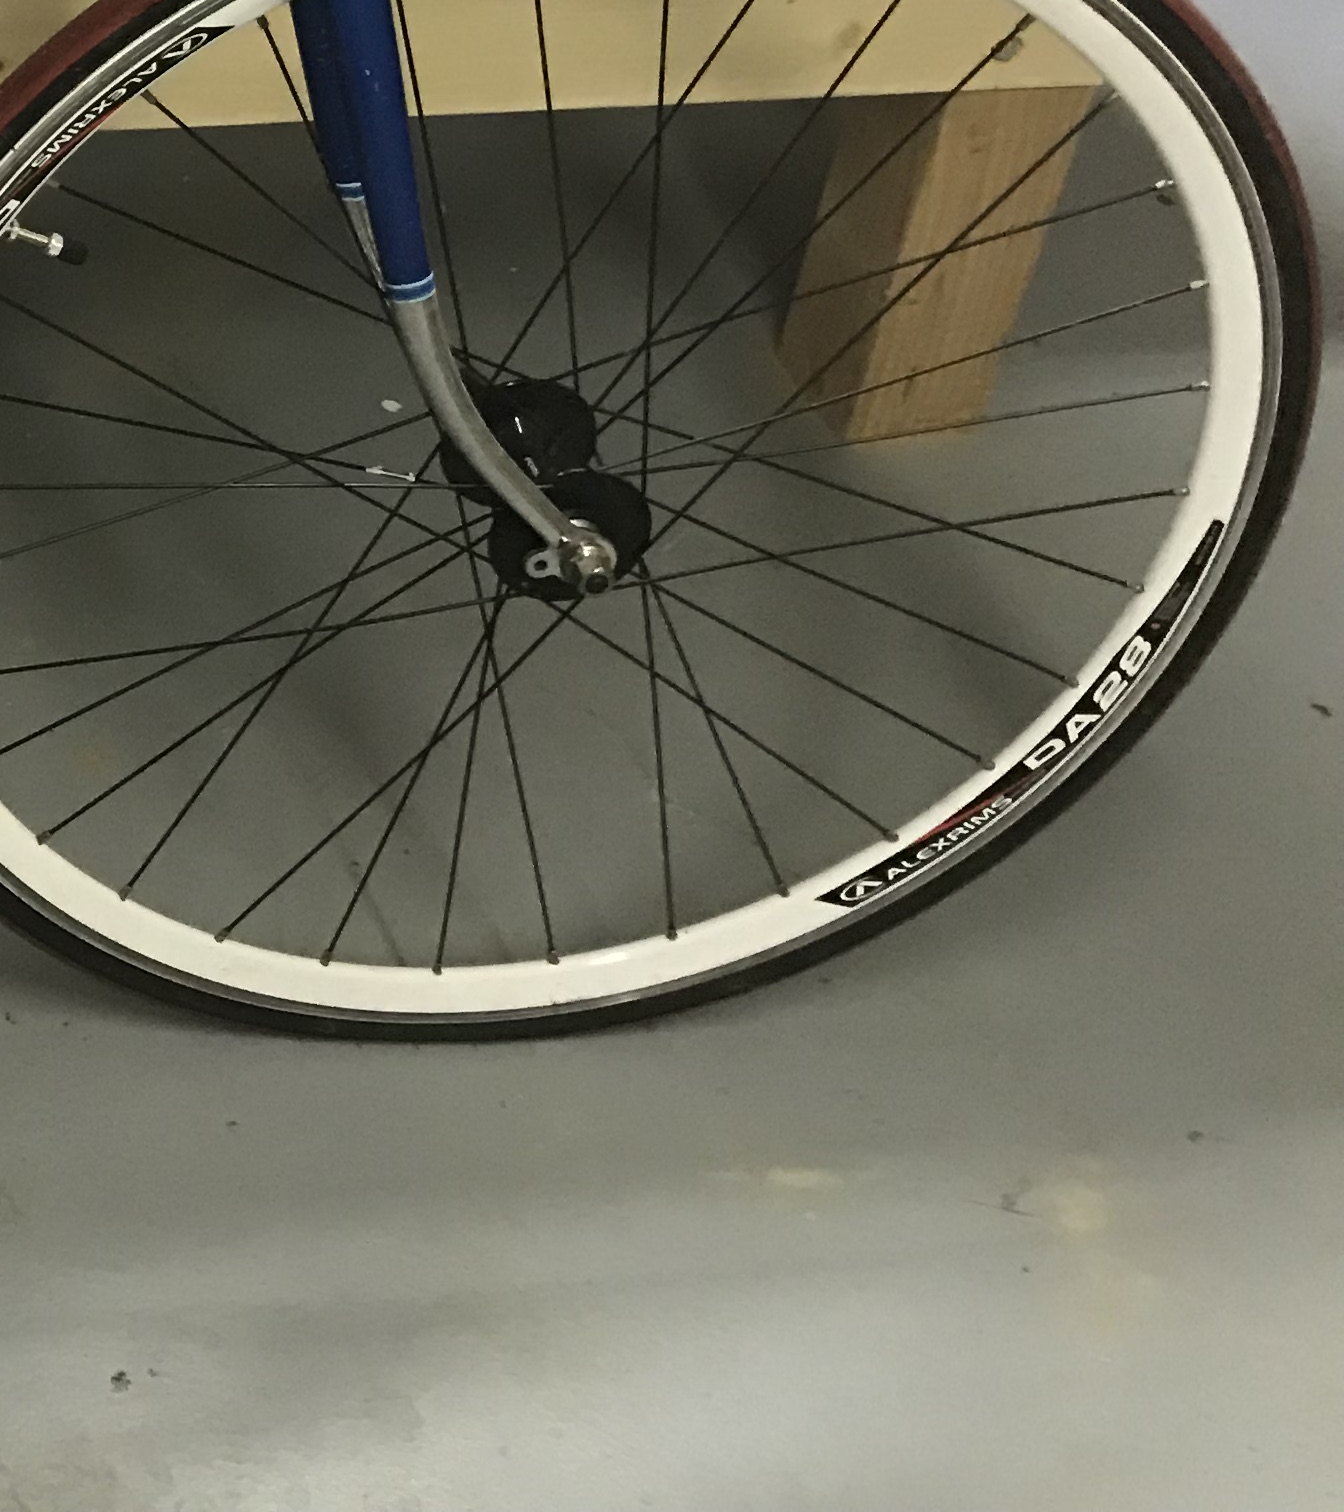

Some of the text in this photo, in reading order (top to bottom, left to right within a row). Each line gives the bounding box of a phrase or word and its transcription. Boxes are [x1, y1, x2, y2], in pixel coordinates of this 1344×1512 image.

[30, 61, 158, 169] ALEXRIMS
[887, 635, 1152, 881] ALEXRIMS DA28
